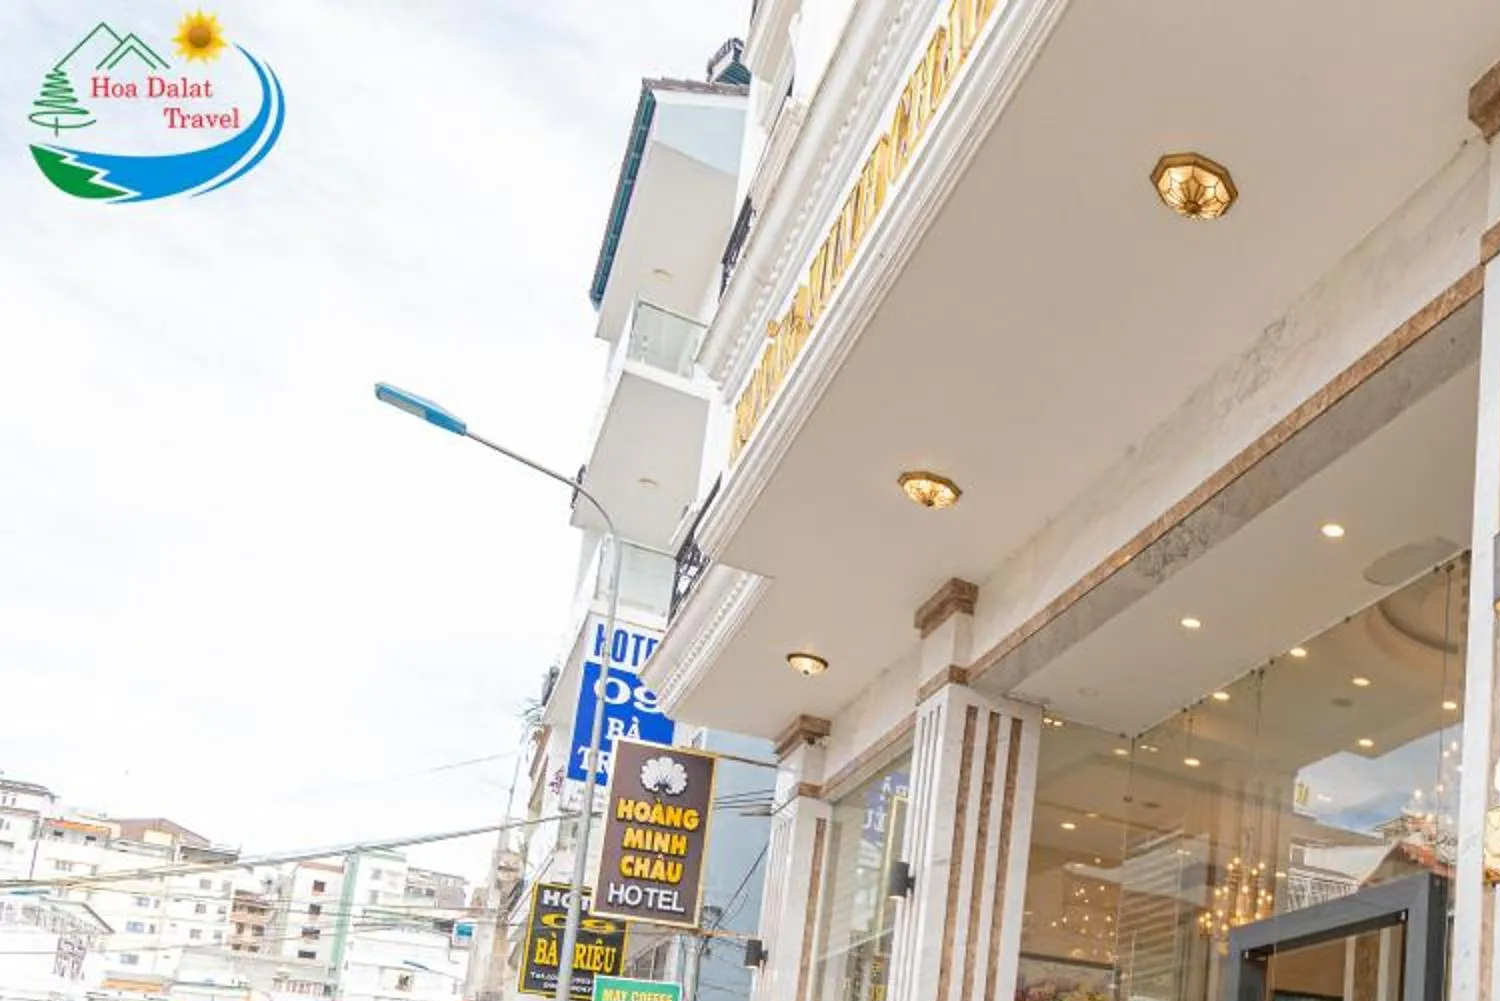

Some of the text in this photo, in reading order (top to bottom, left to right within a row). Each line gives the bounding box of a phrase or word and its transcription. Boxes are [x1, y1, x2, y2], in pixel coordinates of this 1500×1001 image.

[616, 797, 699, 830] HOÀNG
[623, 826, 687, 855] MINH
[620, 853, 684, 884] CHÂU
[608, 882, 685, 912] HOTEL
[534, 930, 558, 967] BÀ
